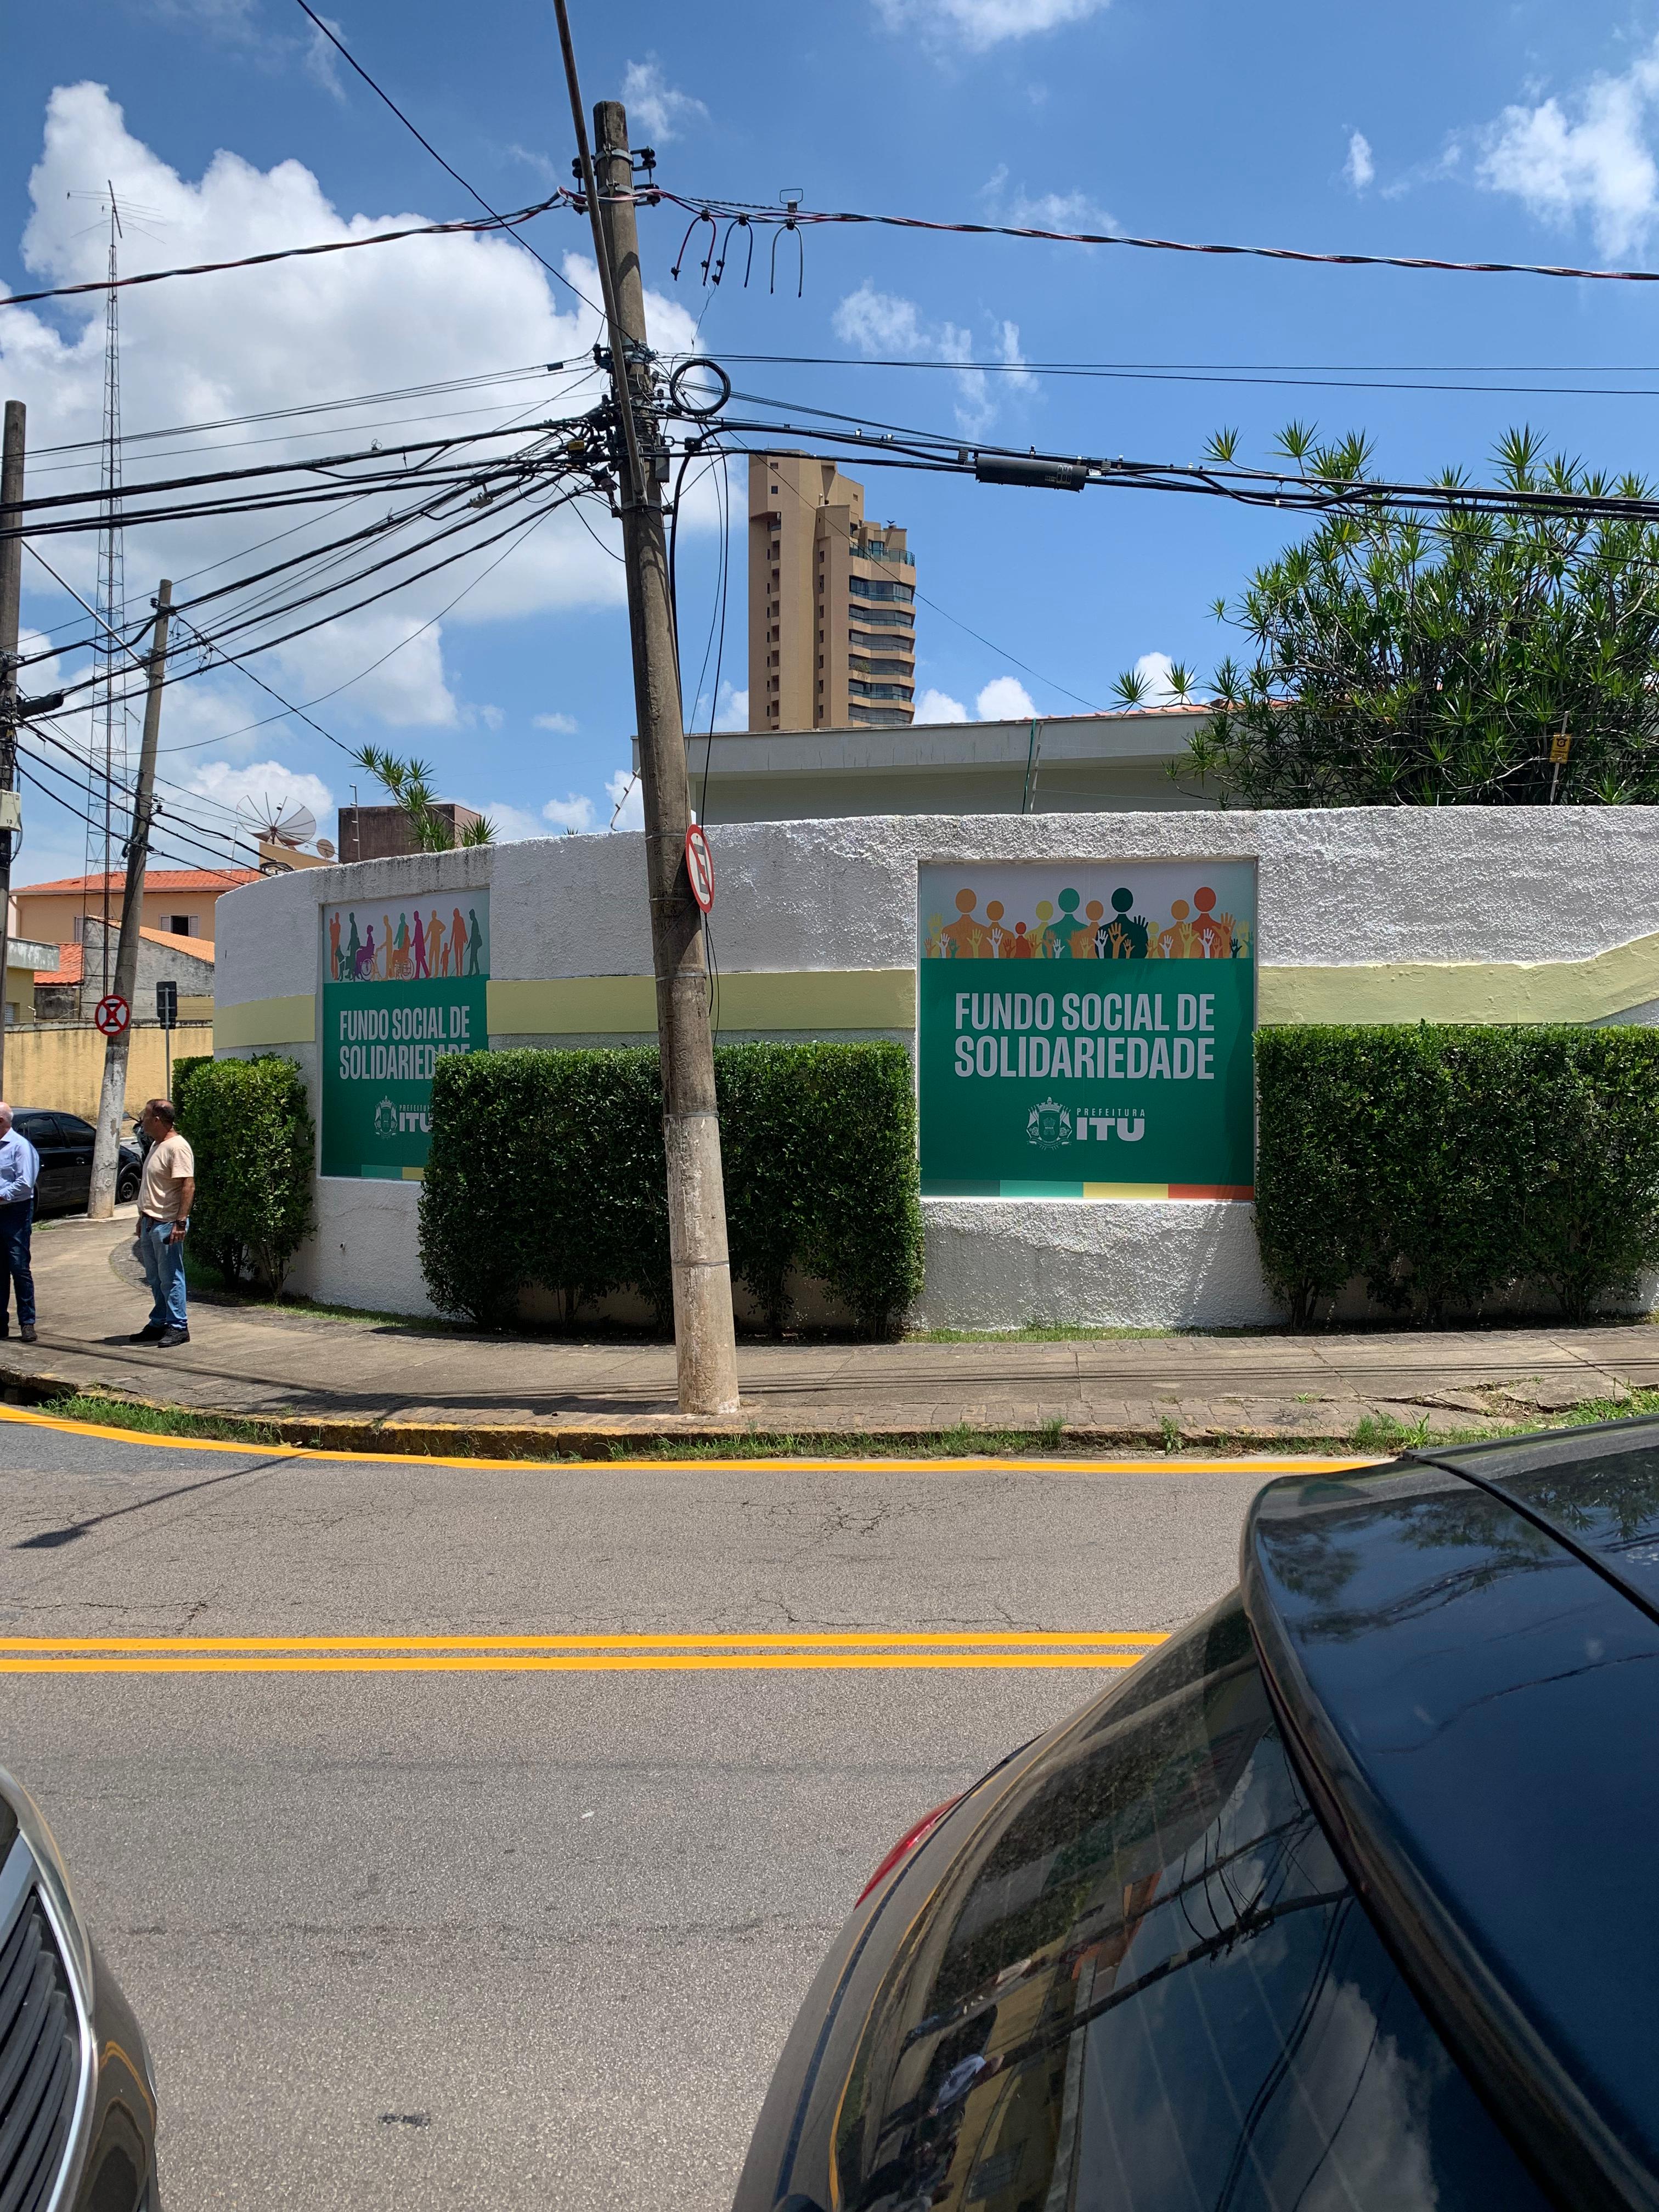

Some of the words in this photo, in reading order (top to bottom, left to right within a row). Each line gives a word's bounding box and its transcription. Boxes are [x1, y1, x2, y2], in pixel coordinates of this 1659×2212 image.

[340, 1009, 389, 1041] FUNDO
[392, 1007, 447, 1040] SOCIAL
[450, 1006, 470, 1039] DE
[955, 993, 1054, 1030] FUNDO
[1062, 993, 1170, 1031] SOCIAL
[1177, 994, 1215, 1031] DE
[340, 1043, 470, 1080] SOLIDARIED
[955, 1035, 1215, 1080] SOLIDARIEDADE
[1076, 1108, 1145, 1117] PREFEITURA
[1076, 1117, 1145, 1142] ITU
